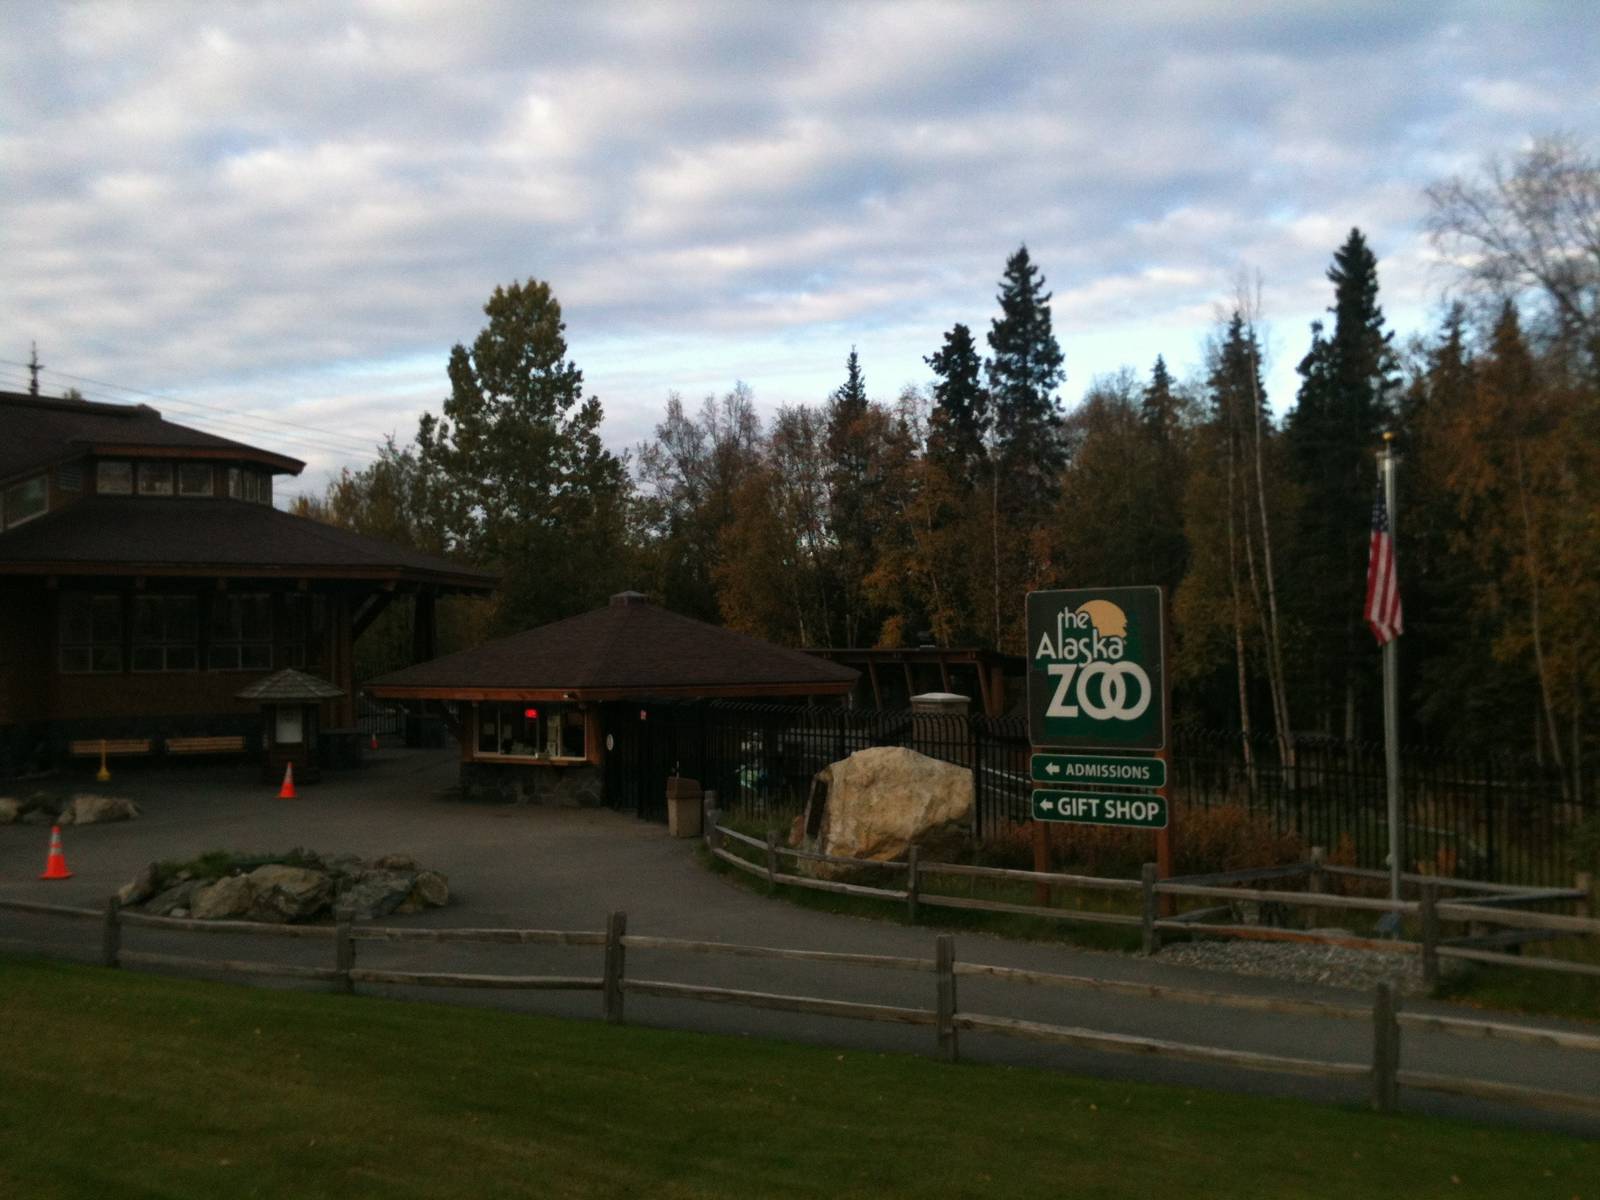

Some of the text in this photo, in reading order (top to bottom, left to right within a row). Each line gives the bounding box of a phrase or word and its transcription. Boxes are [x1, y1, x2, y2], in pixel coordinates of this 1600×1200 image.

[1057, 606, 1089, 629] the
[1035, 628, 1124, 667] Alaska
[1045, 660, 1152, 721] ZOO
[1065, 763, 1150, 779] ADMISSIONS
[1057, 797, 1159, 820] GIFT SHOP
